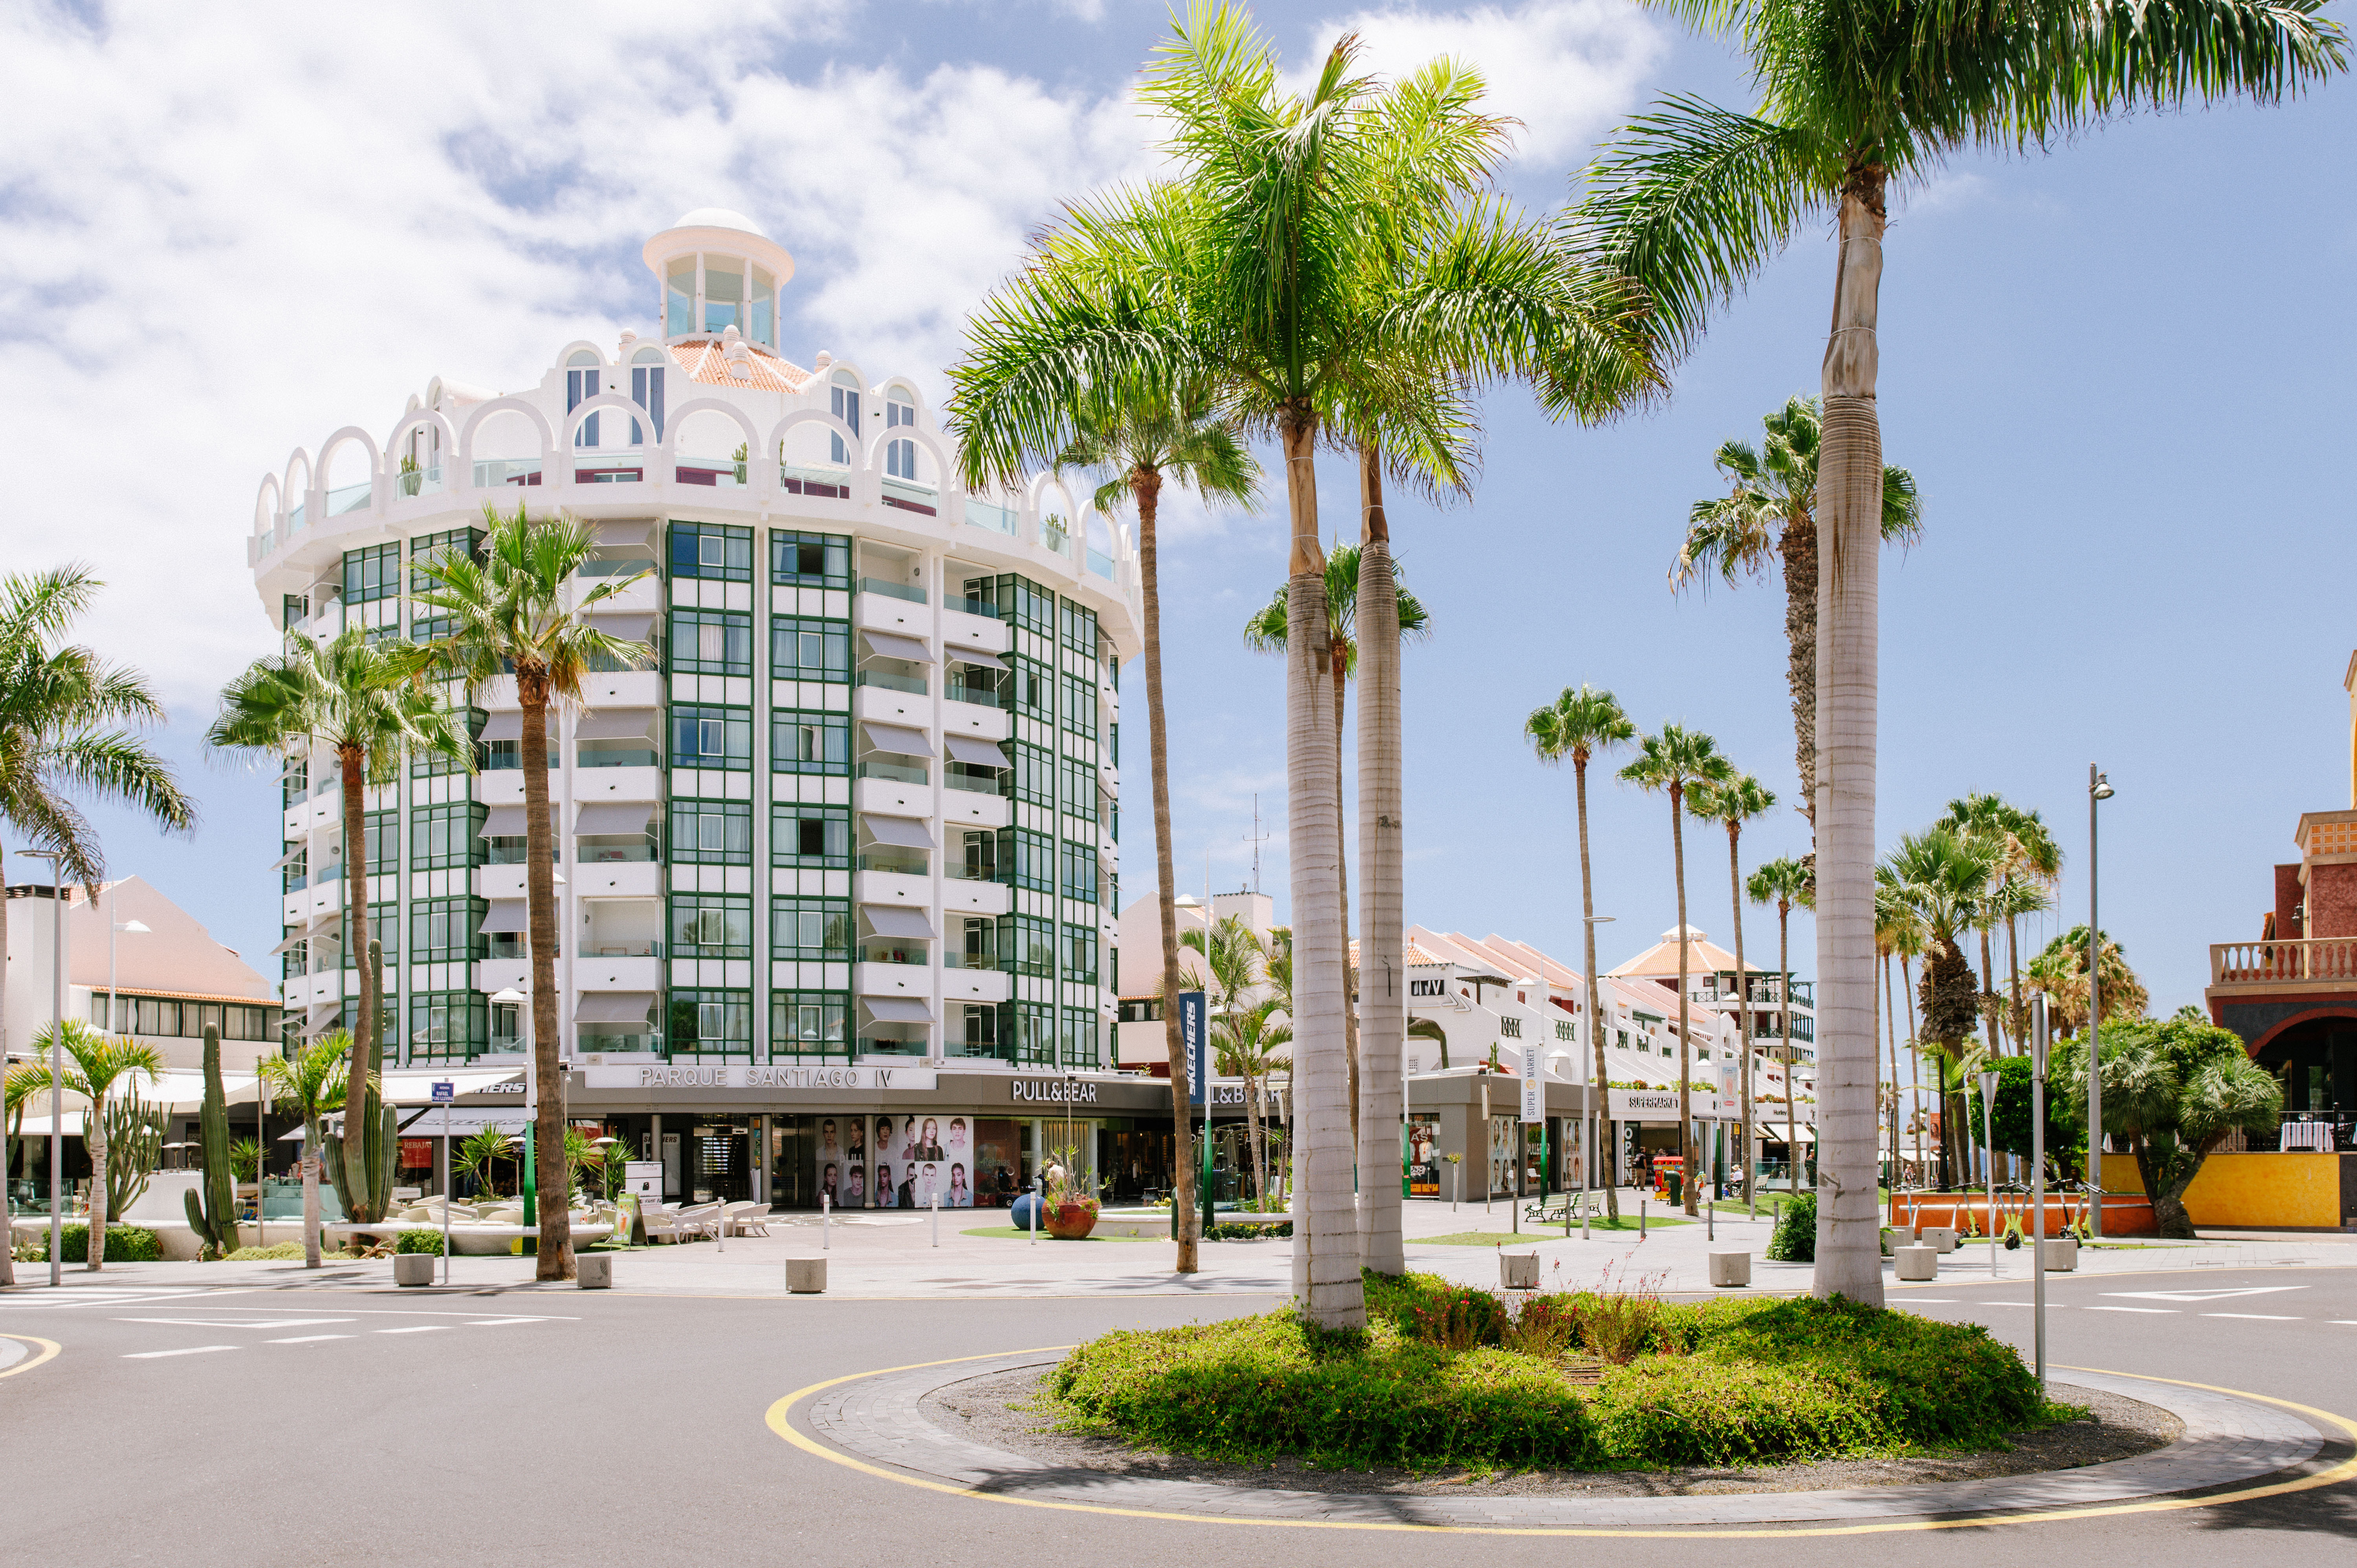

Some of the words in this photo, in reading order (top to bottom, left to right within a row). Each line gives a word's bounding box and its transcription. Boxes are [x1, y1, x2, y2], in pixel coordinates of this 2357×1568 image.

[1187, 1000, 1196, 1096] SKECHERS
[640, 1068, 727, 1086] PARQUE
[746, 1068, 860, 1087] SANTIAGO
[876, 1070, 893, 1087] IV
[1013, 1081, 1097, 1102] PULL&BEAR
[1629, 1097, 1678, 1108] SUPERMARKET
[1624, 1127, 1633, 1180] OPEN
